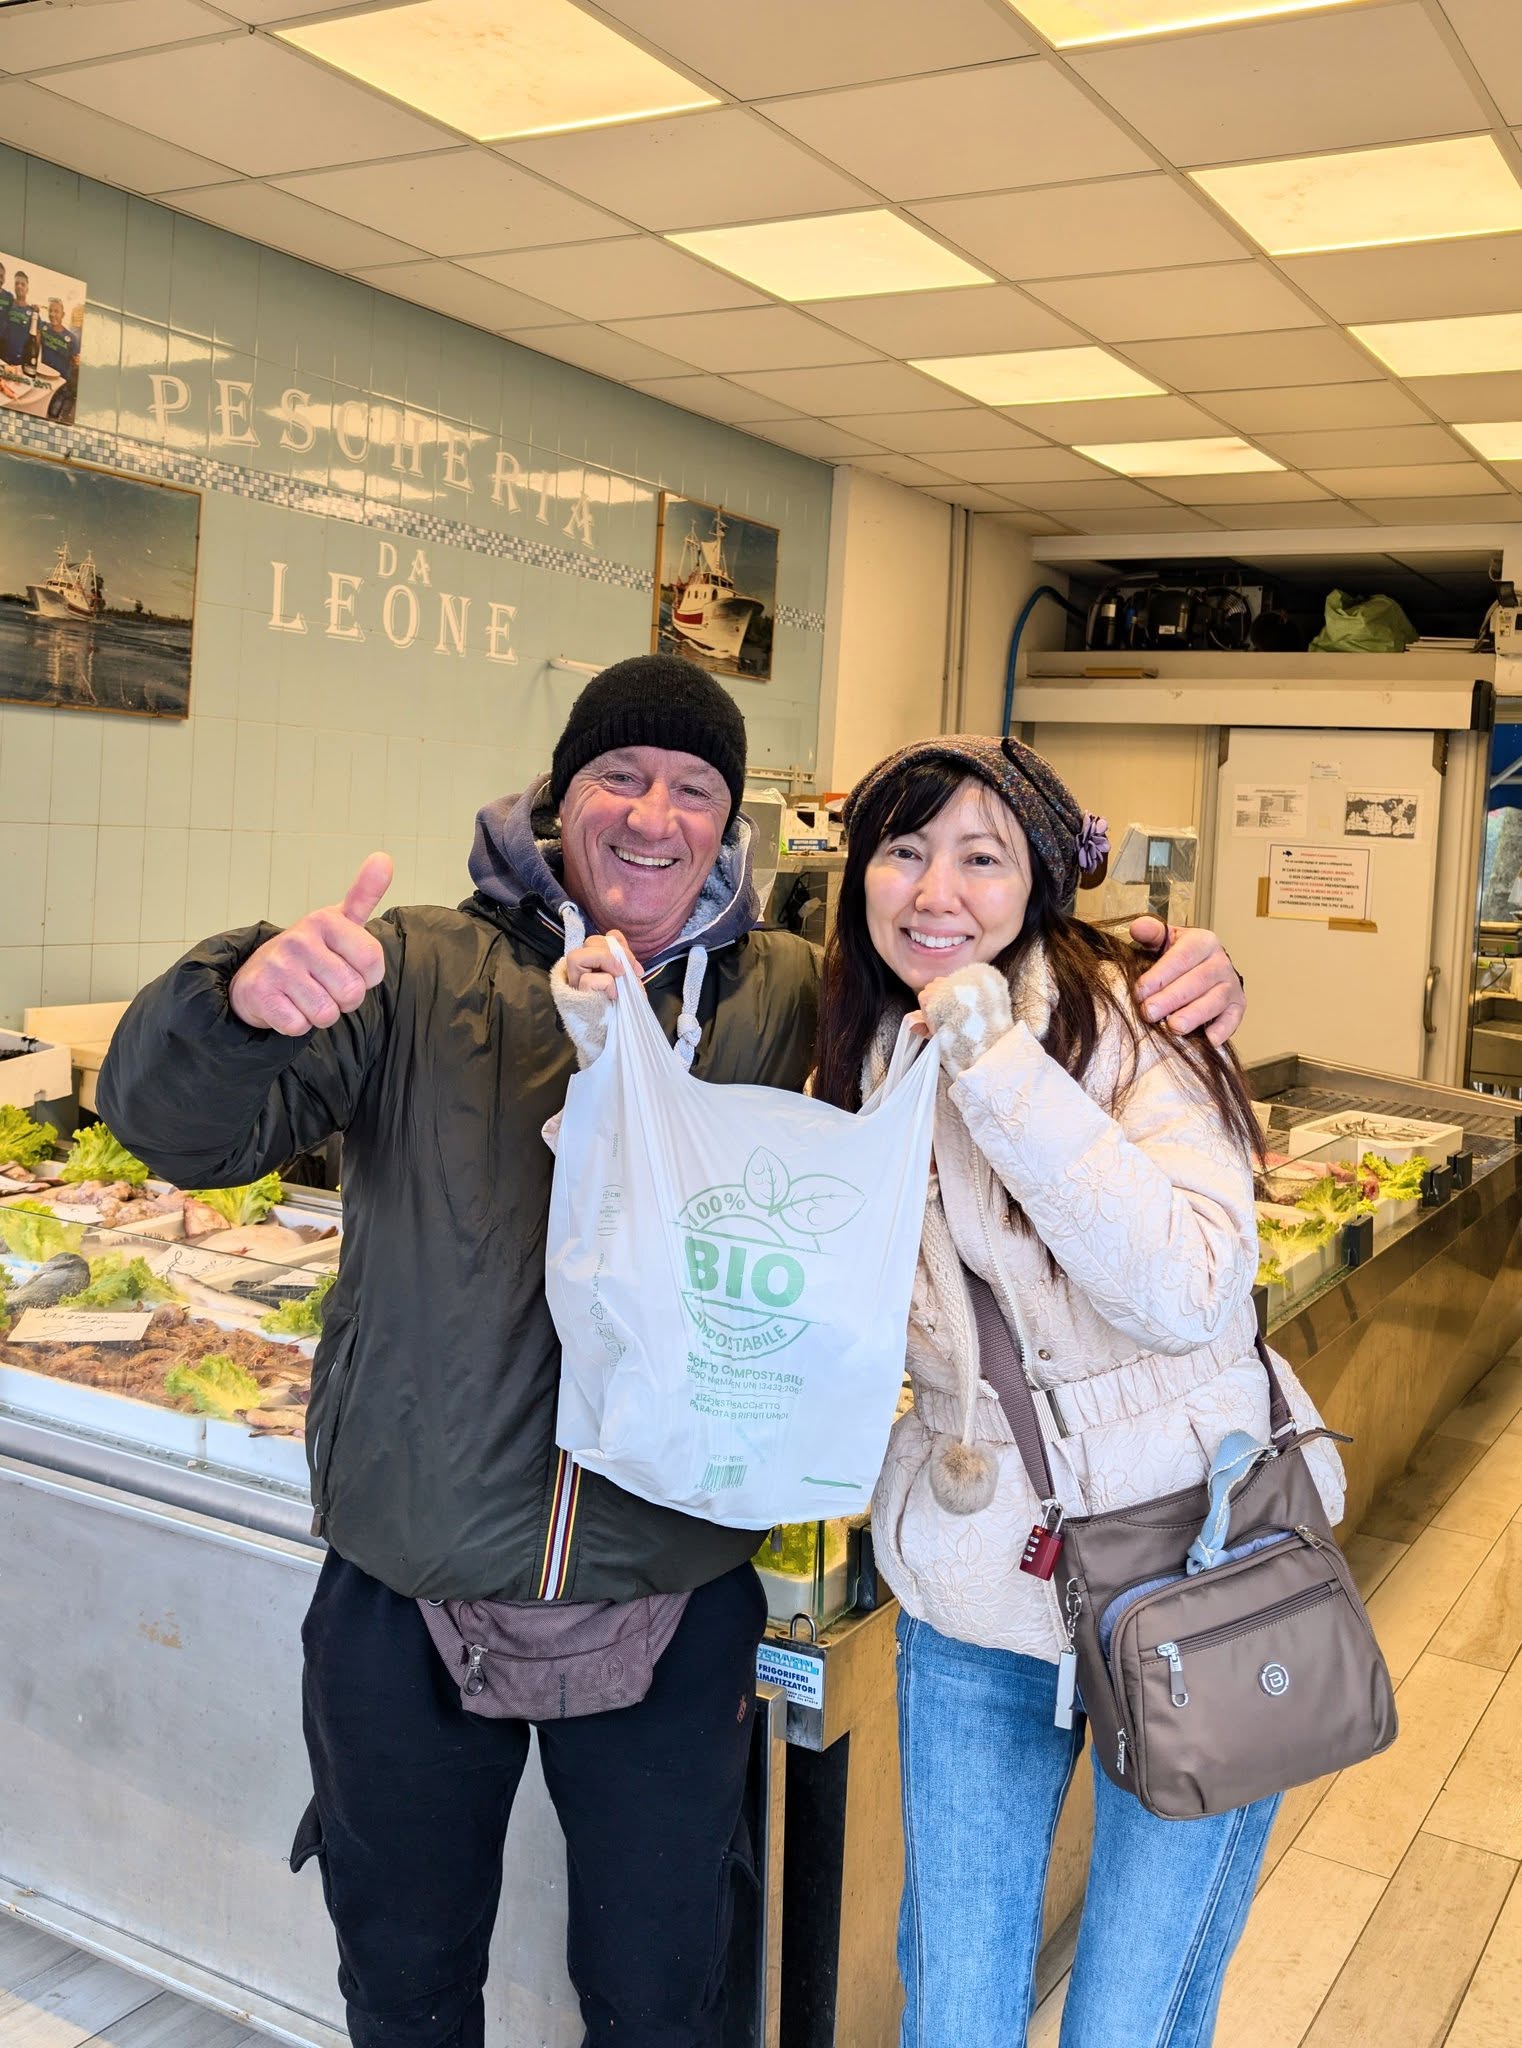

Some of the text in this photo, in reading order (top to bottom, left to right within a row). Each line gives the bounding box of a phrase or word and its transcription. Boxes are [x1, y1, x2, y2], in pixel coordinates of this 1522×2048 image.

[148, 374, 595, 549] PESCHERIA
[377, 541, 432, 587] DA
[268, 561, 519, 665] LEONE
[688, 1192, 746, 1227] 100%
[685, 1236, 805, 1308] BIO
[756, 1673, 816, 1694] LIMATIZZATORI
[759, 1664, 808, 1683] FRIGORIFERI
